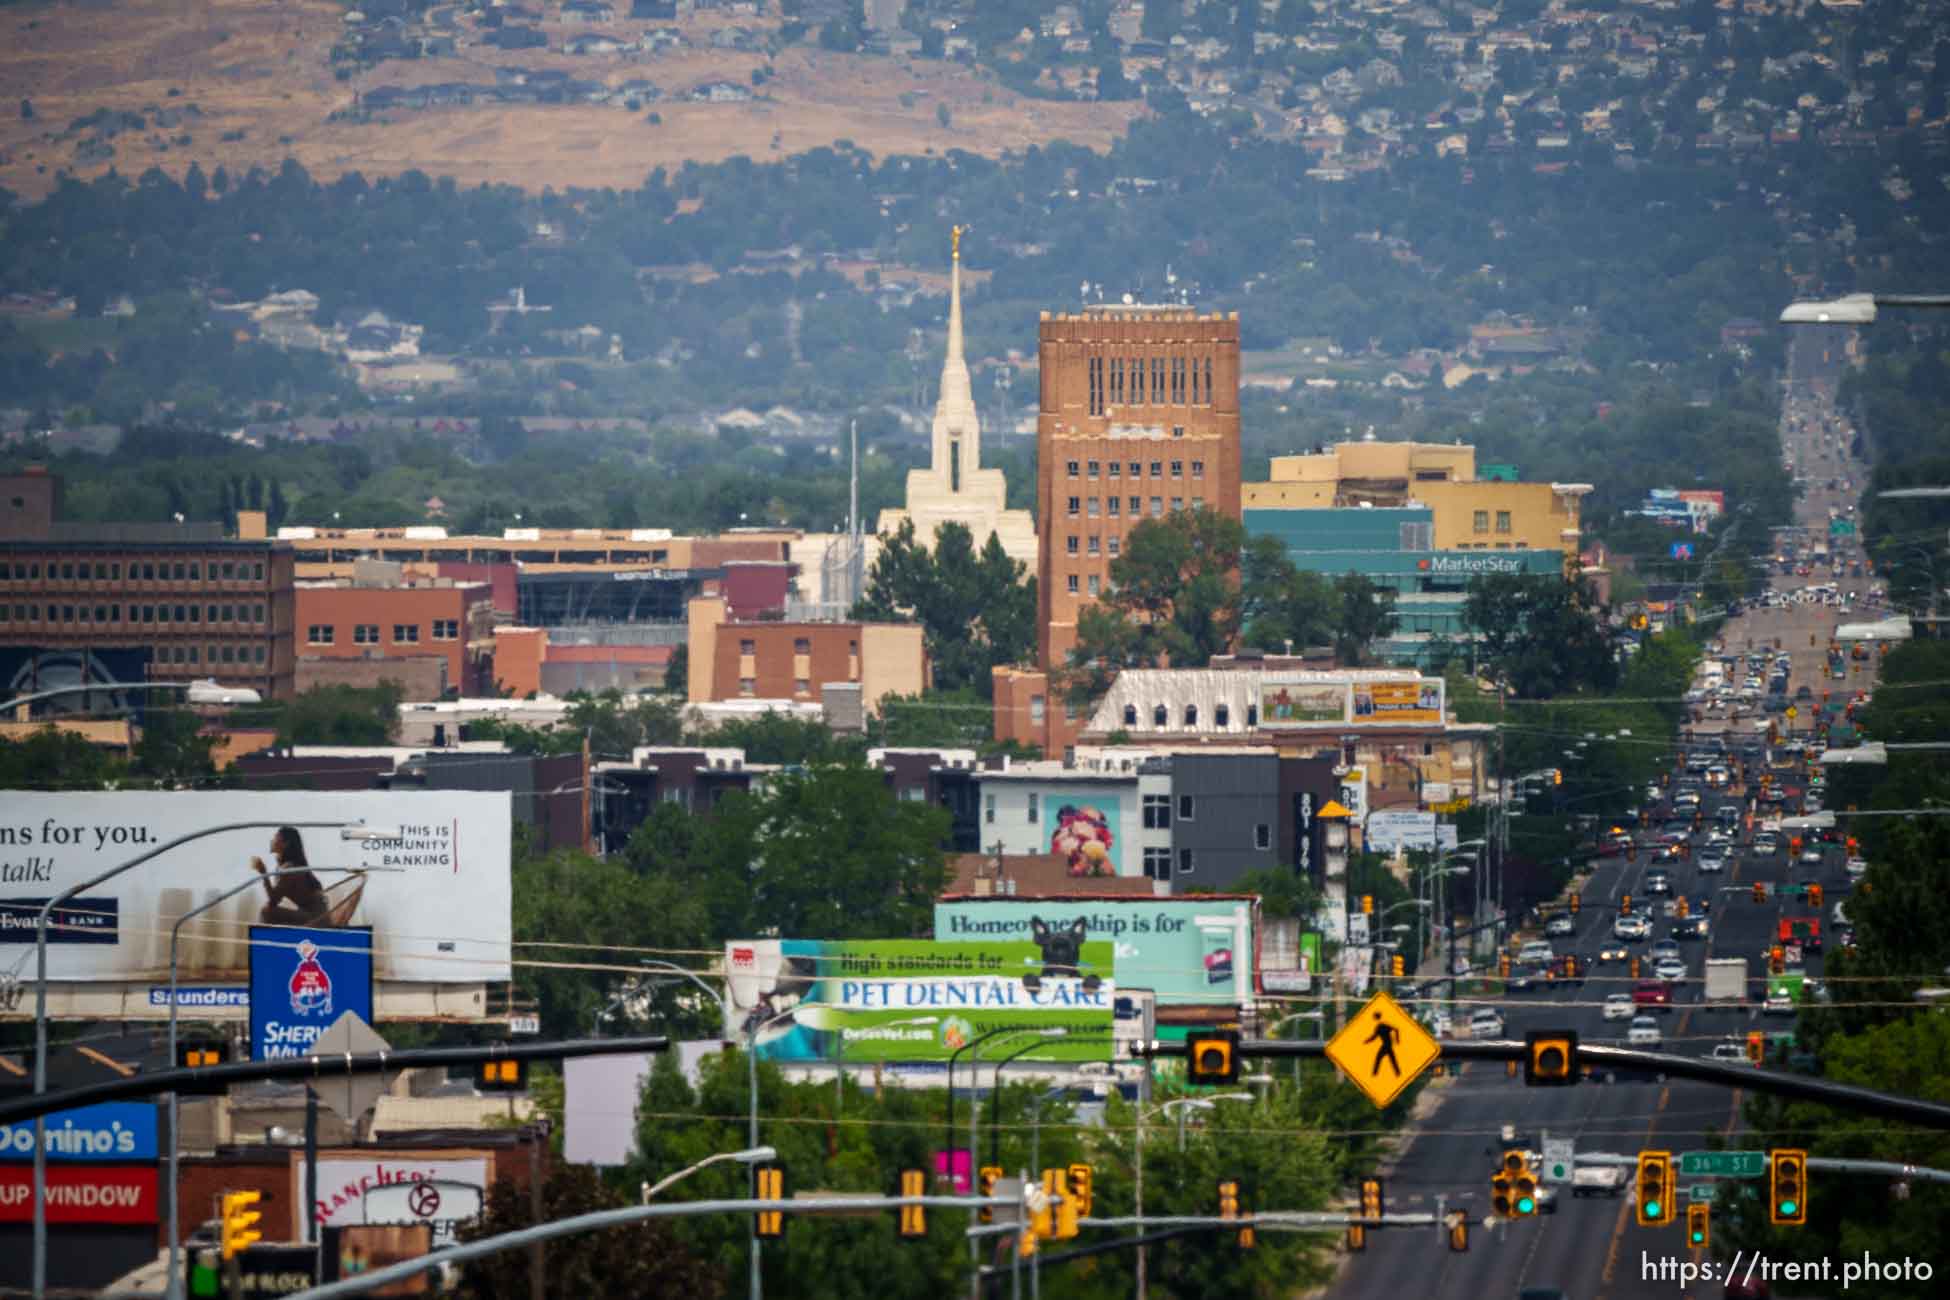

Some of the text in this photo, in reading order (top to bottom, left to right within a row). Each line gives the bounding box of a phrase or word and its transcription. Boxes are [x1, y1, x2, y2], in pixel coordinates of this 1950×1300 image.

[1432, 555, 1520, 572] MarketStar
[0, 818, 157, 851] ns for you.
[400, 825, 449, 837] THIS IS
[361, 839, 449, 851] COMMUNITY
[2, 857, 54, 882] talk!
[383, 854, 449, 866] BANKING
[950, 912, 1186, 934] Homeoneship is for
[841, 952, 1003, 974] High standards for
[842, 981, 895, 1006] PET
[905, 981, 1021, 1006] DENTAL
